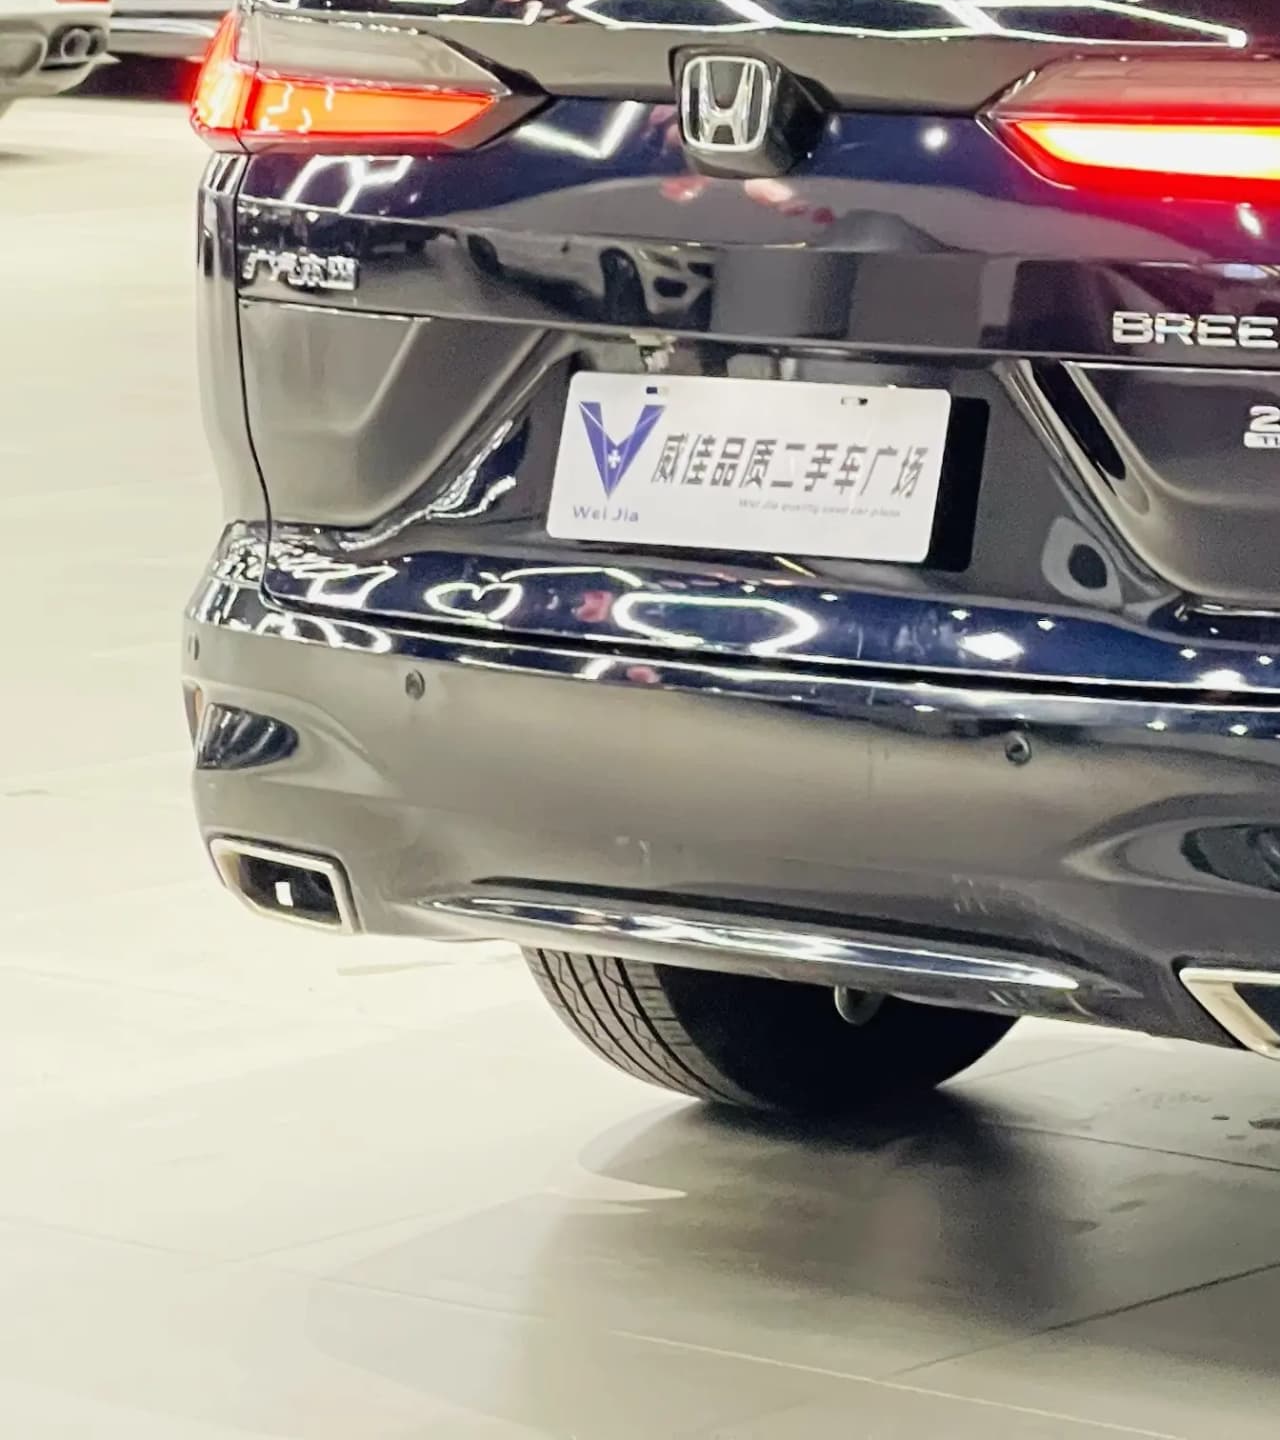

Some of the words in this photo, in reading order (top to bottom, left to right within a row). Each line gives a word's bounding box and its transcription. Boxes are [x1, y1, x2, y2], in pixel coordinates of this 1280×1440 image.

[650, 431, 929, 499] 威佳品质二手车广场
